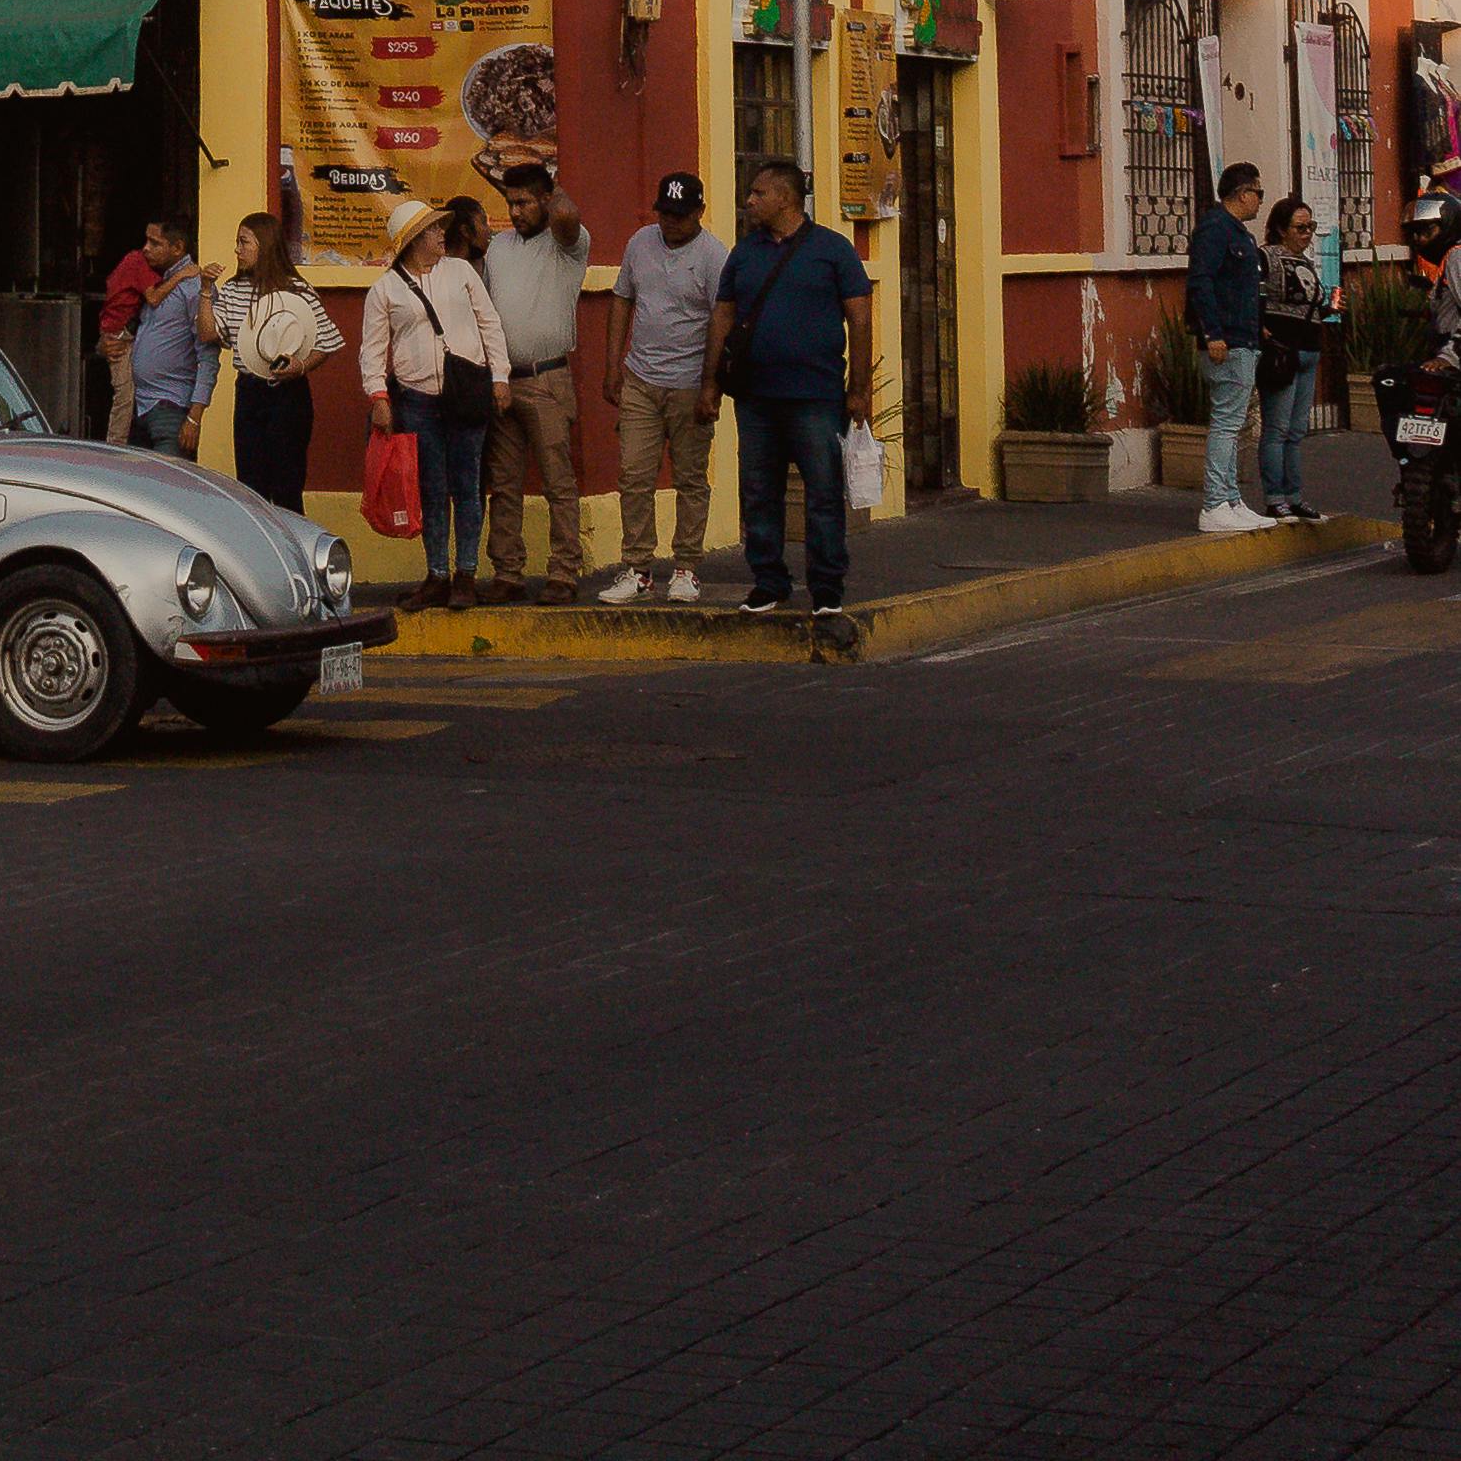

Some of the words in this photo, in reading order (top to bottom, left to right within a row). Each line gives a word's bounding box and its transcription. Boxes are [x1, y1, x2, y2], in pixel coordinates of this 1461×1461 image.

[387, 41, 418, 53] $295
[391, 90, 421, 103] $240
[392, 132, 420, 144] $160
[329, 169, 387, 191] BEBIDAS
